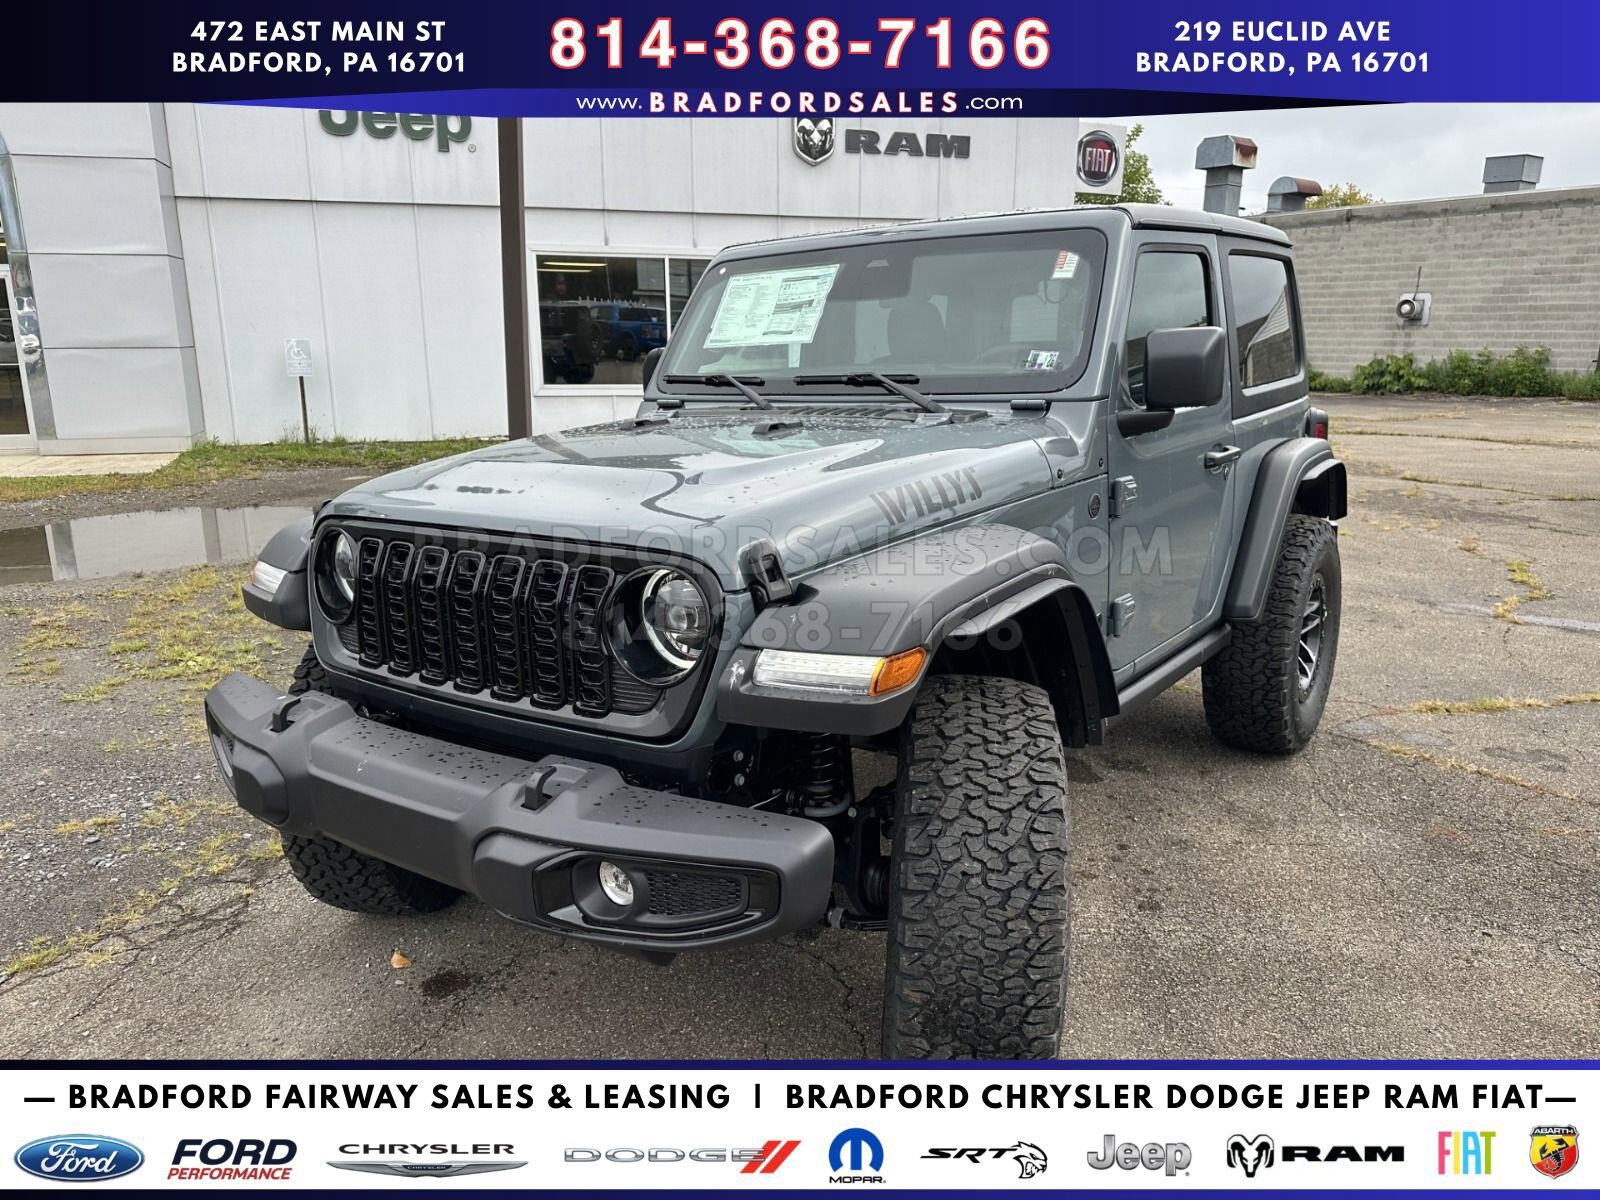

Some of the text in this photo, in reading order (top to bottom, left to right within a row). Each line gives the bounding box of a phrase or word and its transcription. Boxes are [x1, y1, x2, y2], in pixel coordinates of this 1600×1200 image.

[844, 128, 971, 159] RAM
[1085, 147, 1112, 173] FIAT
[868, 465, 983, 526] WILLYS
